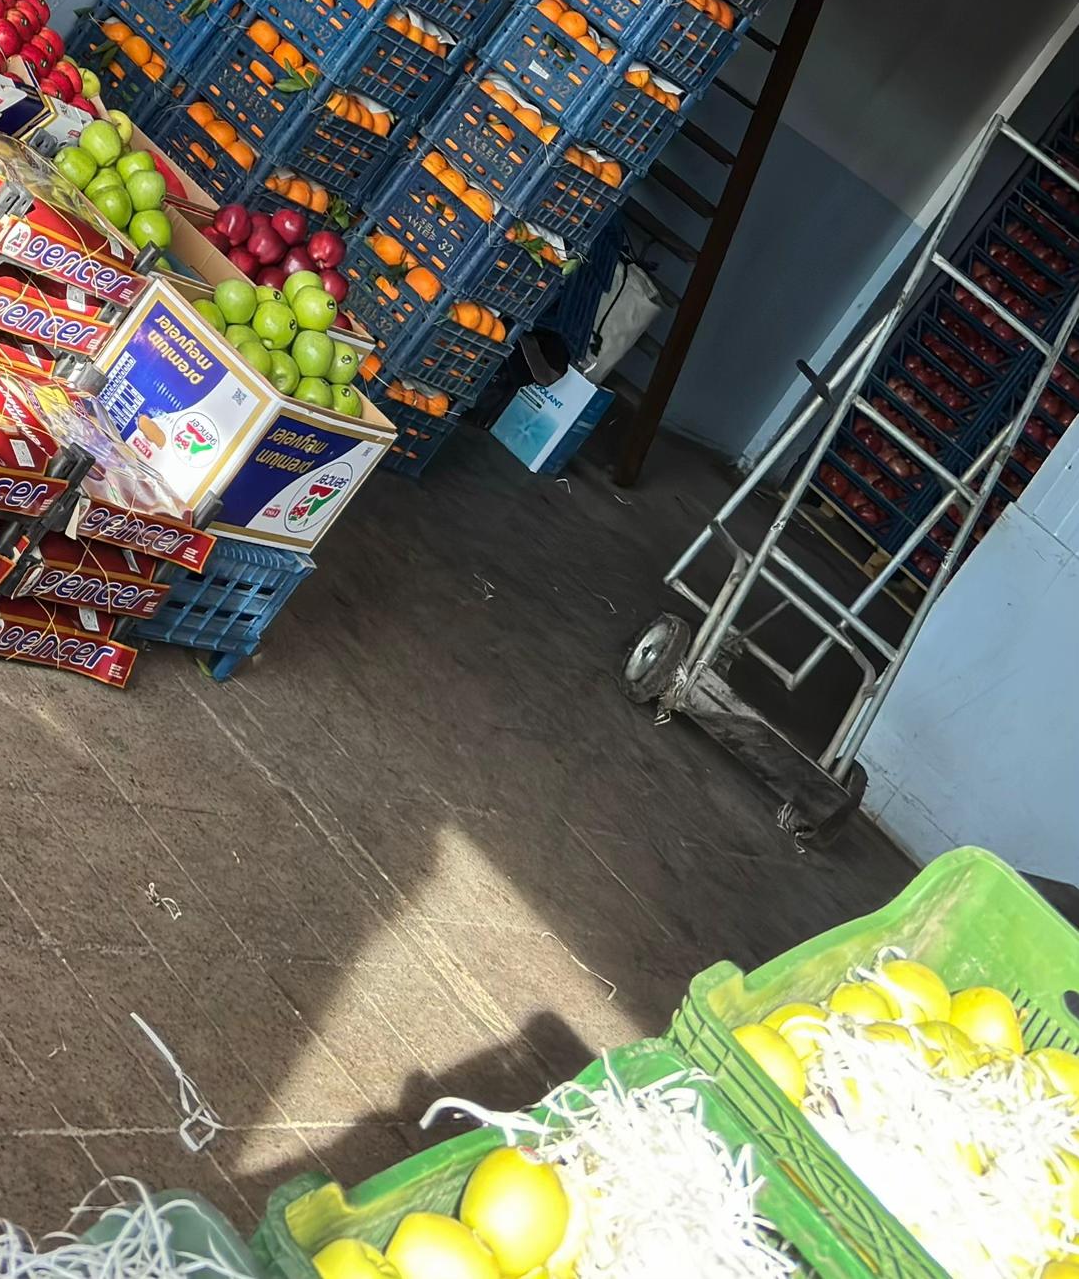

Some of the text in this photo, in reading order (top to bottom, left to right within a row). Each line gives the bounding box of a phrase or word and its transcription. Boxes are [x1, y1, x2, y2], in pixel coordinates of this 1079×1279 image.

[21, 235, 132, 299] gencer
[437, 238, 454, 258] 32
[145, 330, 205, 386] premium
[154, 313, 214, 371] meyveler
[254, 447, 315, 475] premium
[267, 426, 331, 455] meyveler
[84, 506, 194, 555] gencer
[37, 570, 155, 611] gencer
